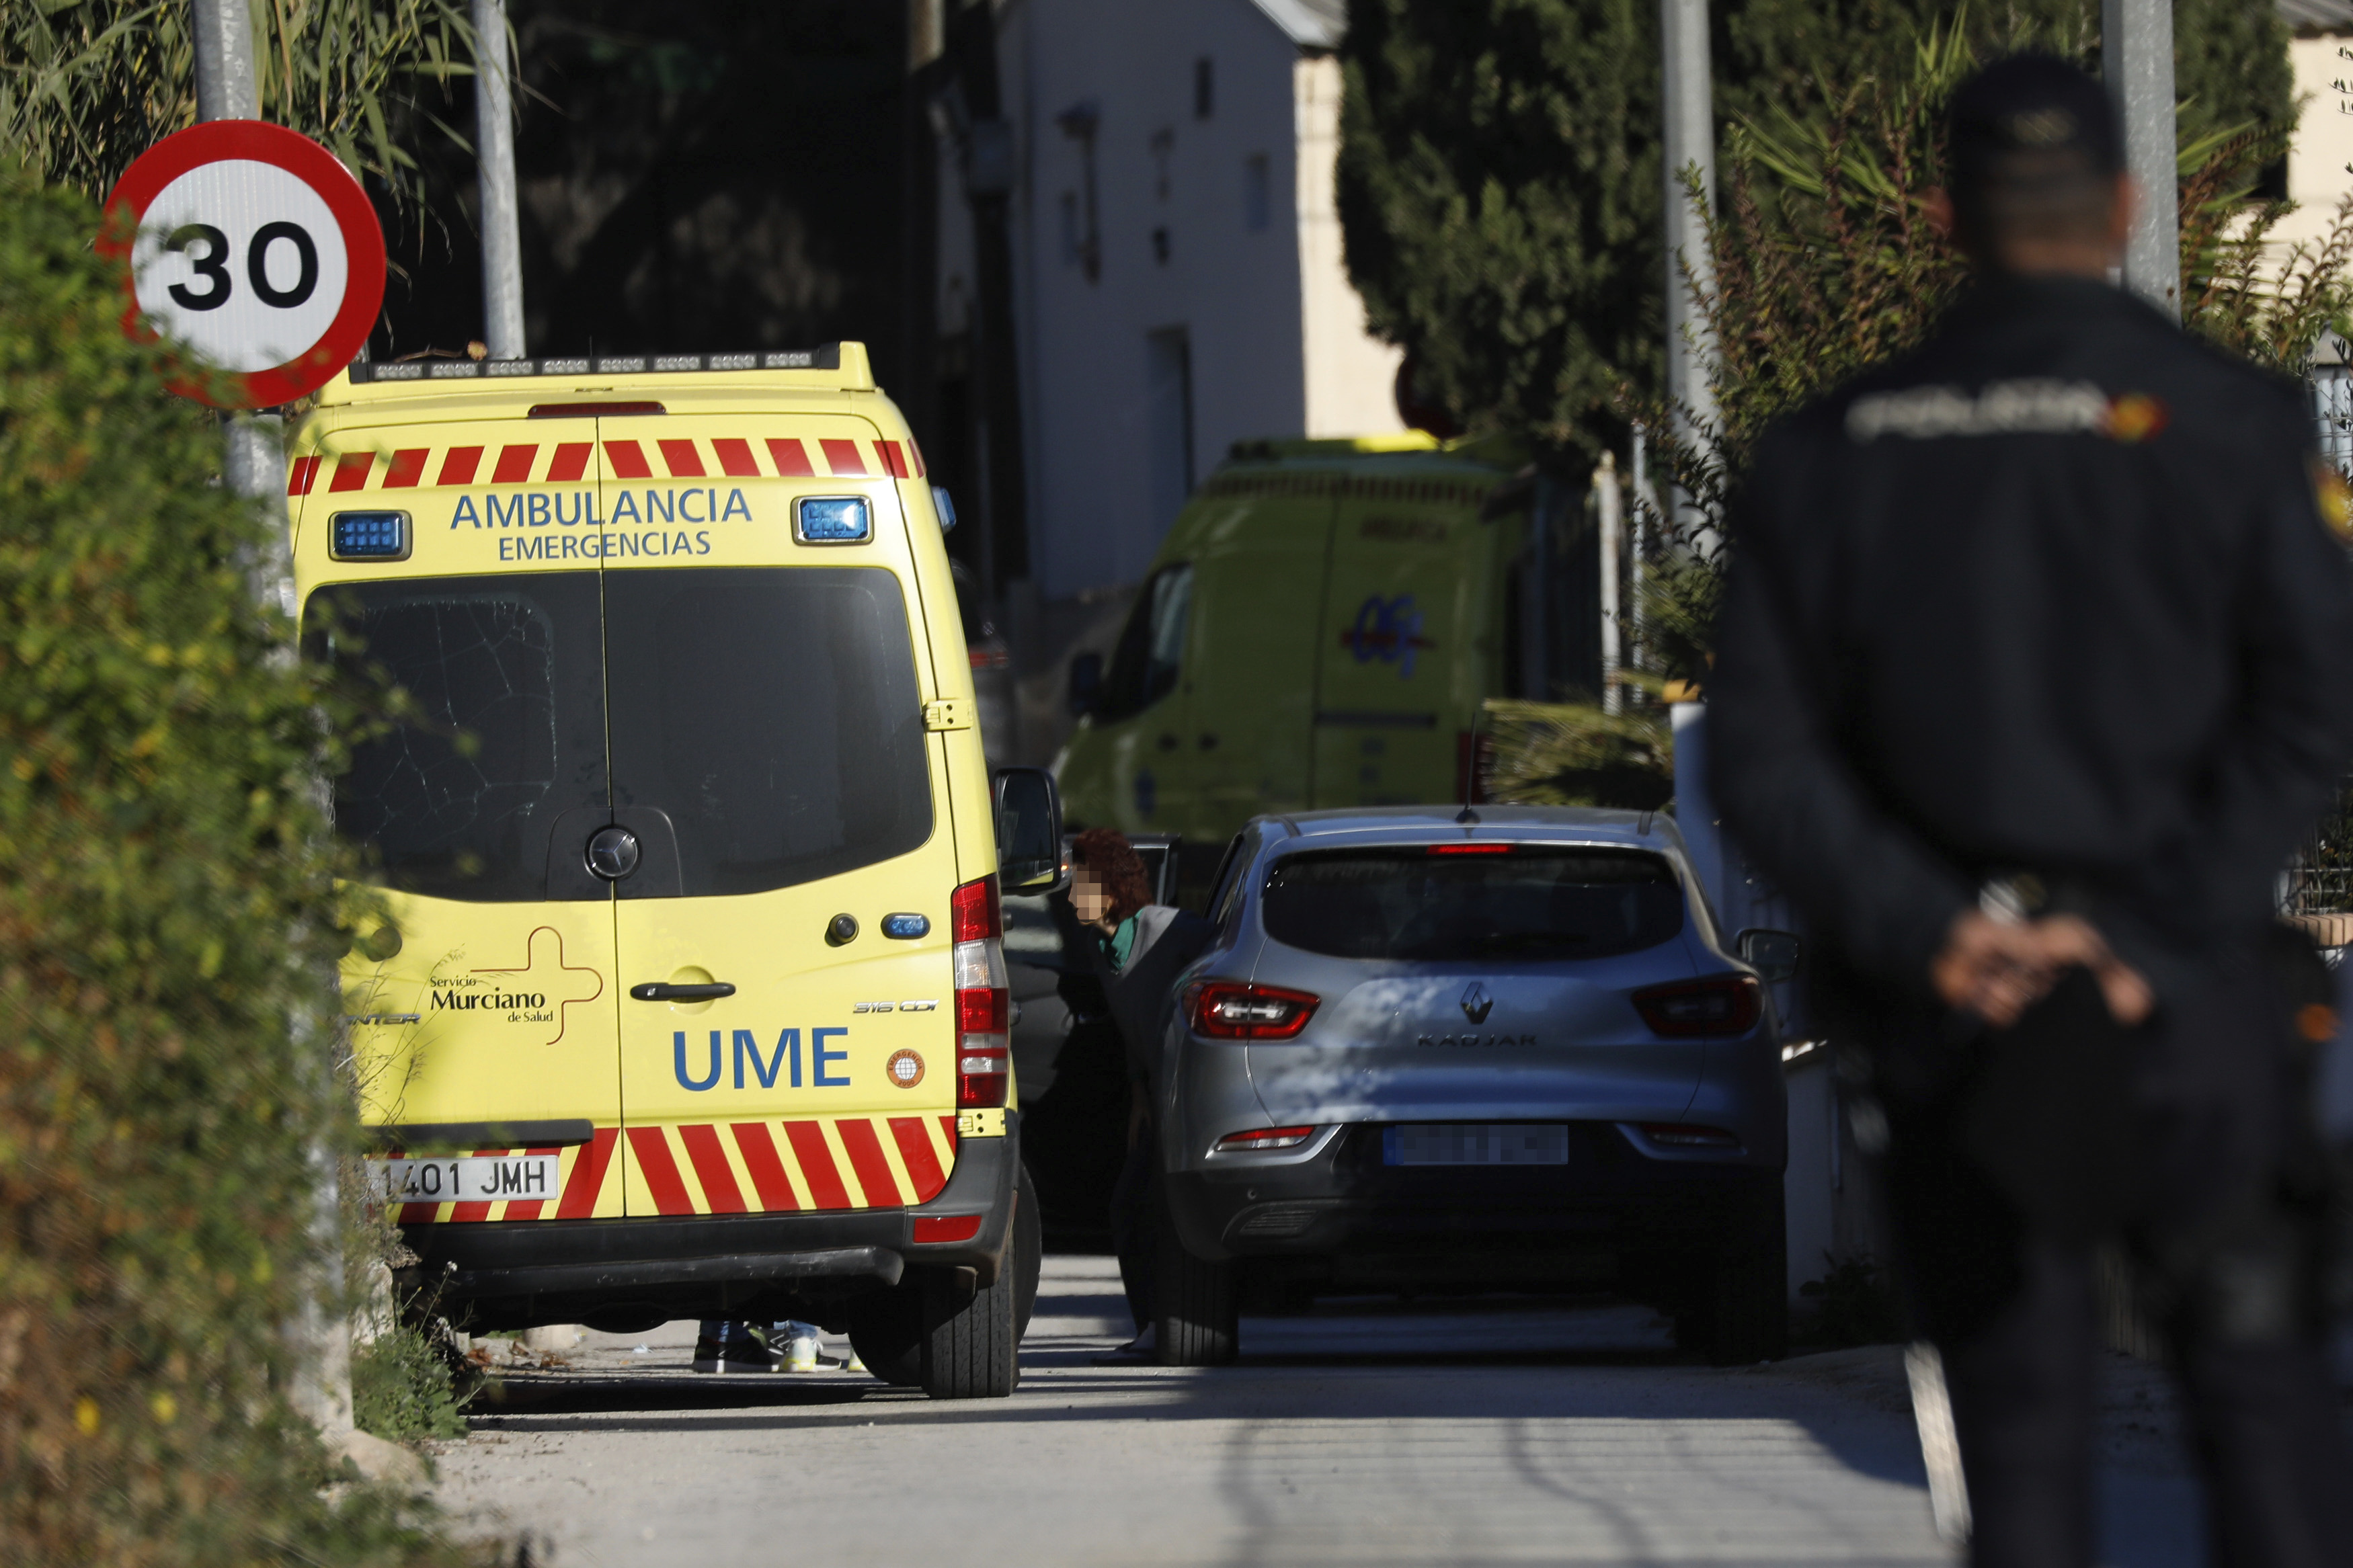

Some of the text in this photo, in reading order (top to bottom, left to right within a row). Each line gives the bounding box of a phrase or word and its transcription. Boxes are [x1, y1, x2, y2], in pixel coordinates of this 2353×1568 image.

[165, 220, 319, 311] 30
[450, 488, 752, 530] AMBULANCIA
[499, 531, 711, 561] EMERGENCIAS
[430, 975, 476, 987] Servicio
[430, 987, 546, 1010] Murciano
[853, 999, 940, 1014] 316 CDI
[508, 1010, 553, 1022] de Salud
[1417, 1034, 1538, 1046] KADJAR
[673, 1027, 851, 1091] UME
[381, 1161, 545, 1196] 1401 JMH
